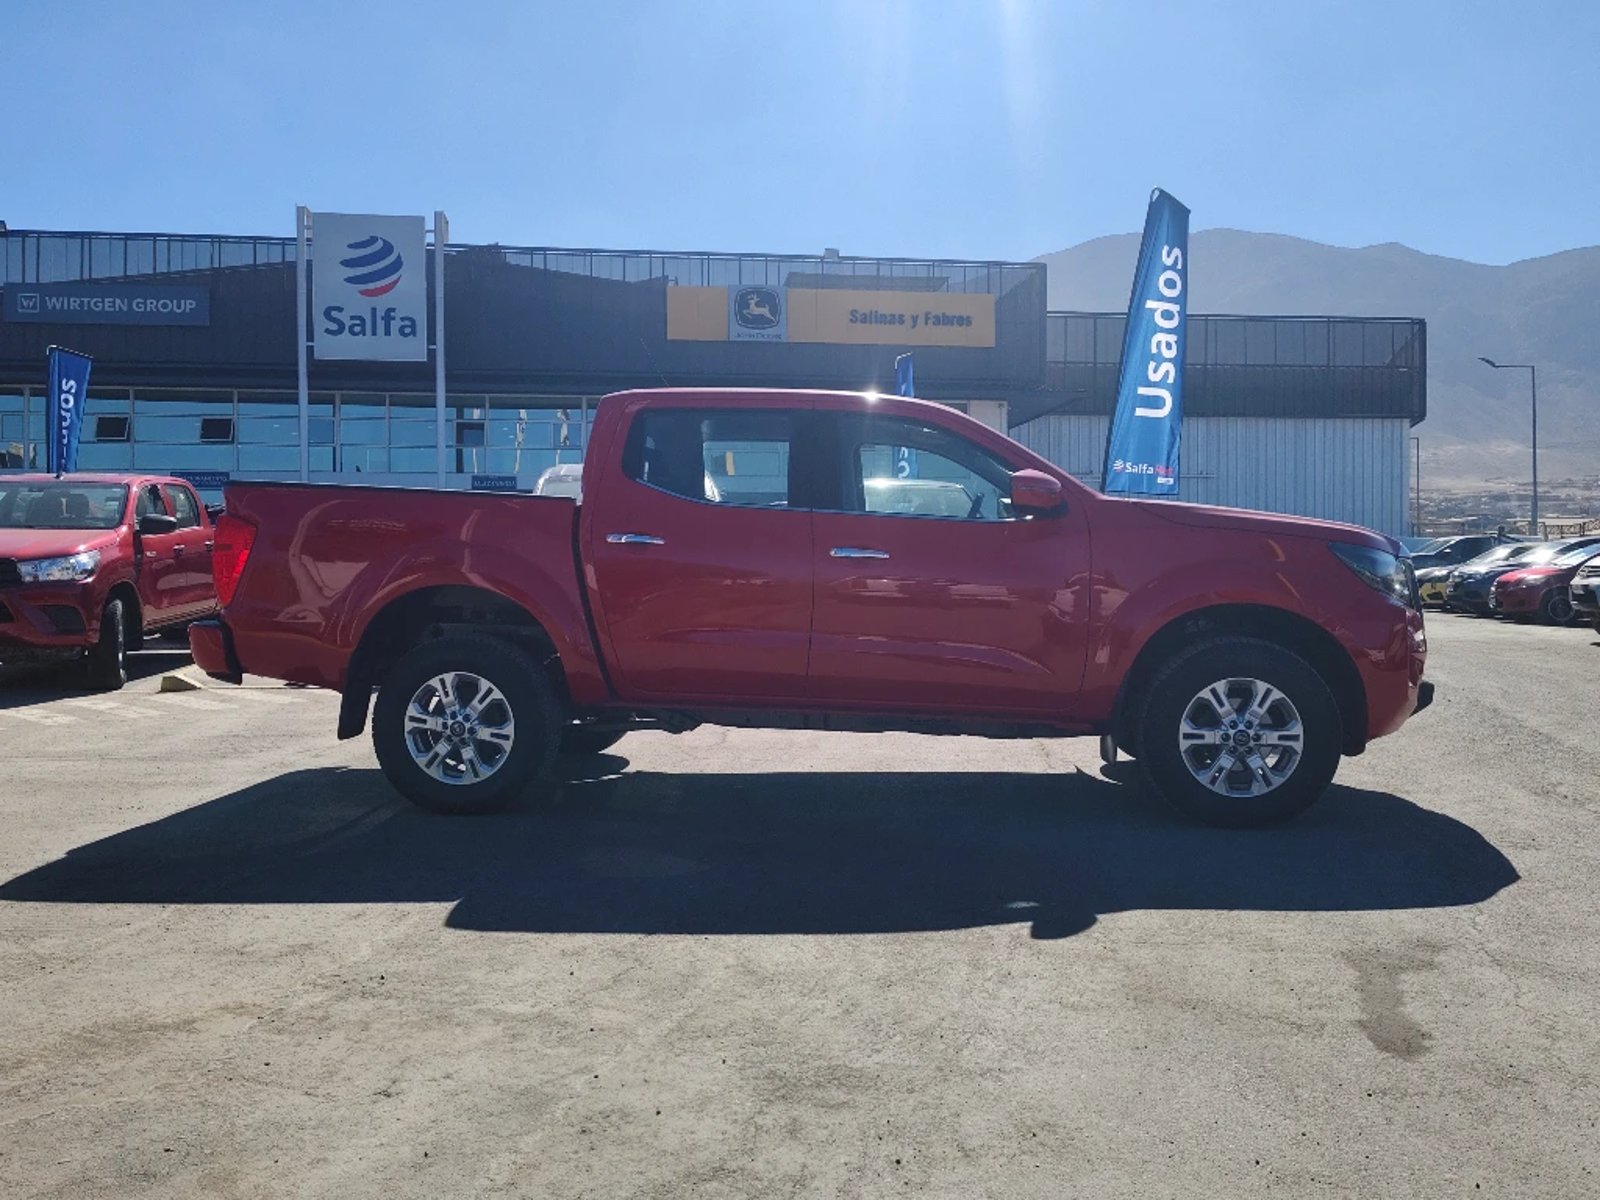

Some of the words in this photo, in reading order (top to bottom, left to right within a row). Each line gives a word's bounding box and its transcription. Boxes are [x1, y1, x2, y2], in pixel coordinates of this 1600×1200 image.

[45, 296, 128, 312] WIRTGEN
[132, 298, 197, 314] GROUP
[322, 305, 417, 338] Salfa
[849, 308, 906, 326] Salinas
[910, 313, 919, 329] y
[1134, 244, 1183, 419] Usados
[1124, 461, 1154, 475] Salfa
